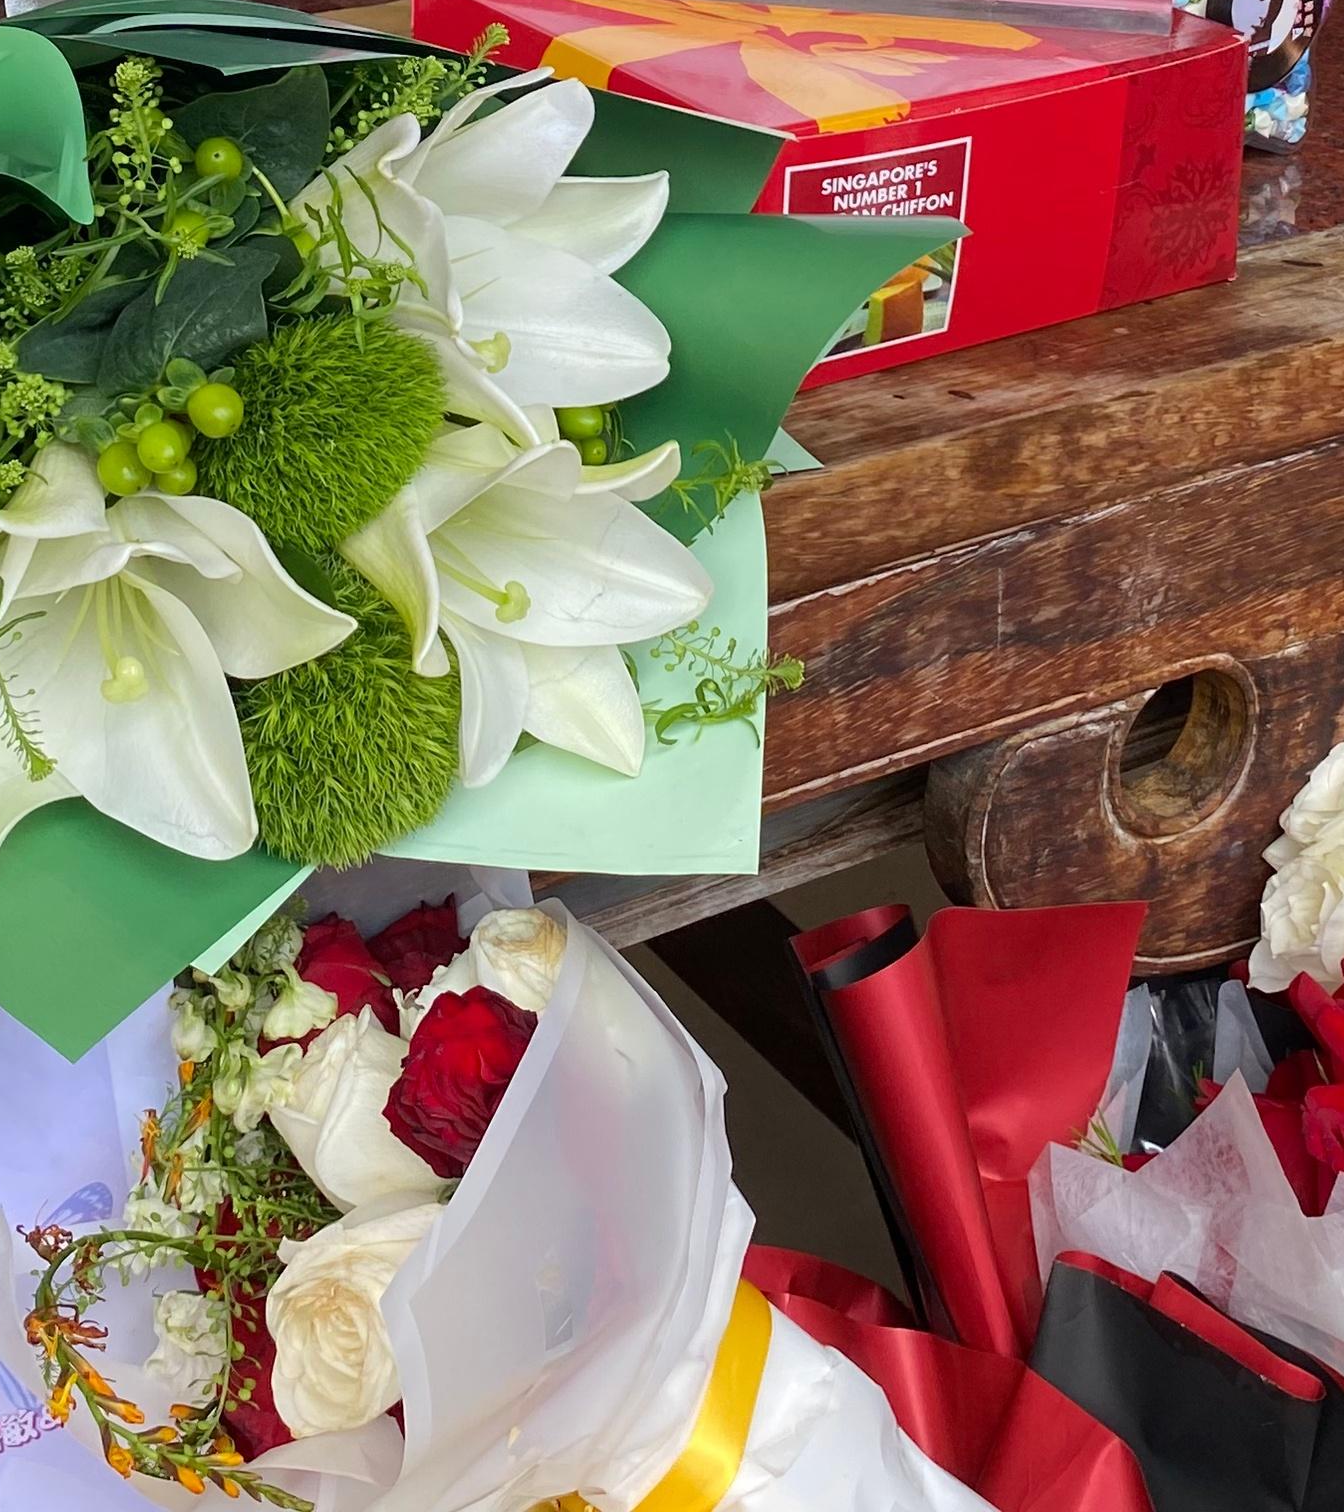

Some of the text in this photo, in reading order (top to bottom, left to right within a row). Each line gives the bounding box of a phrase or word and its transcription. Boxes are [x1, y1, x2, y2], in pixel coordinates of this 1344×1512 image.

[821, 160, 938, 196] SINGAPORE'S
[833, 180, 923, 212] NUMBER 1
[880, 191, 955, 216] CHIFFON
